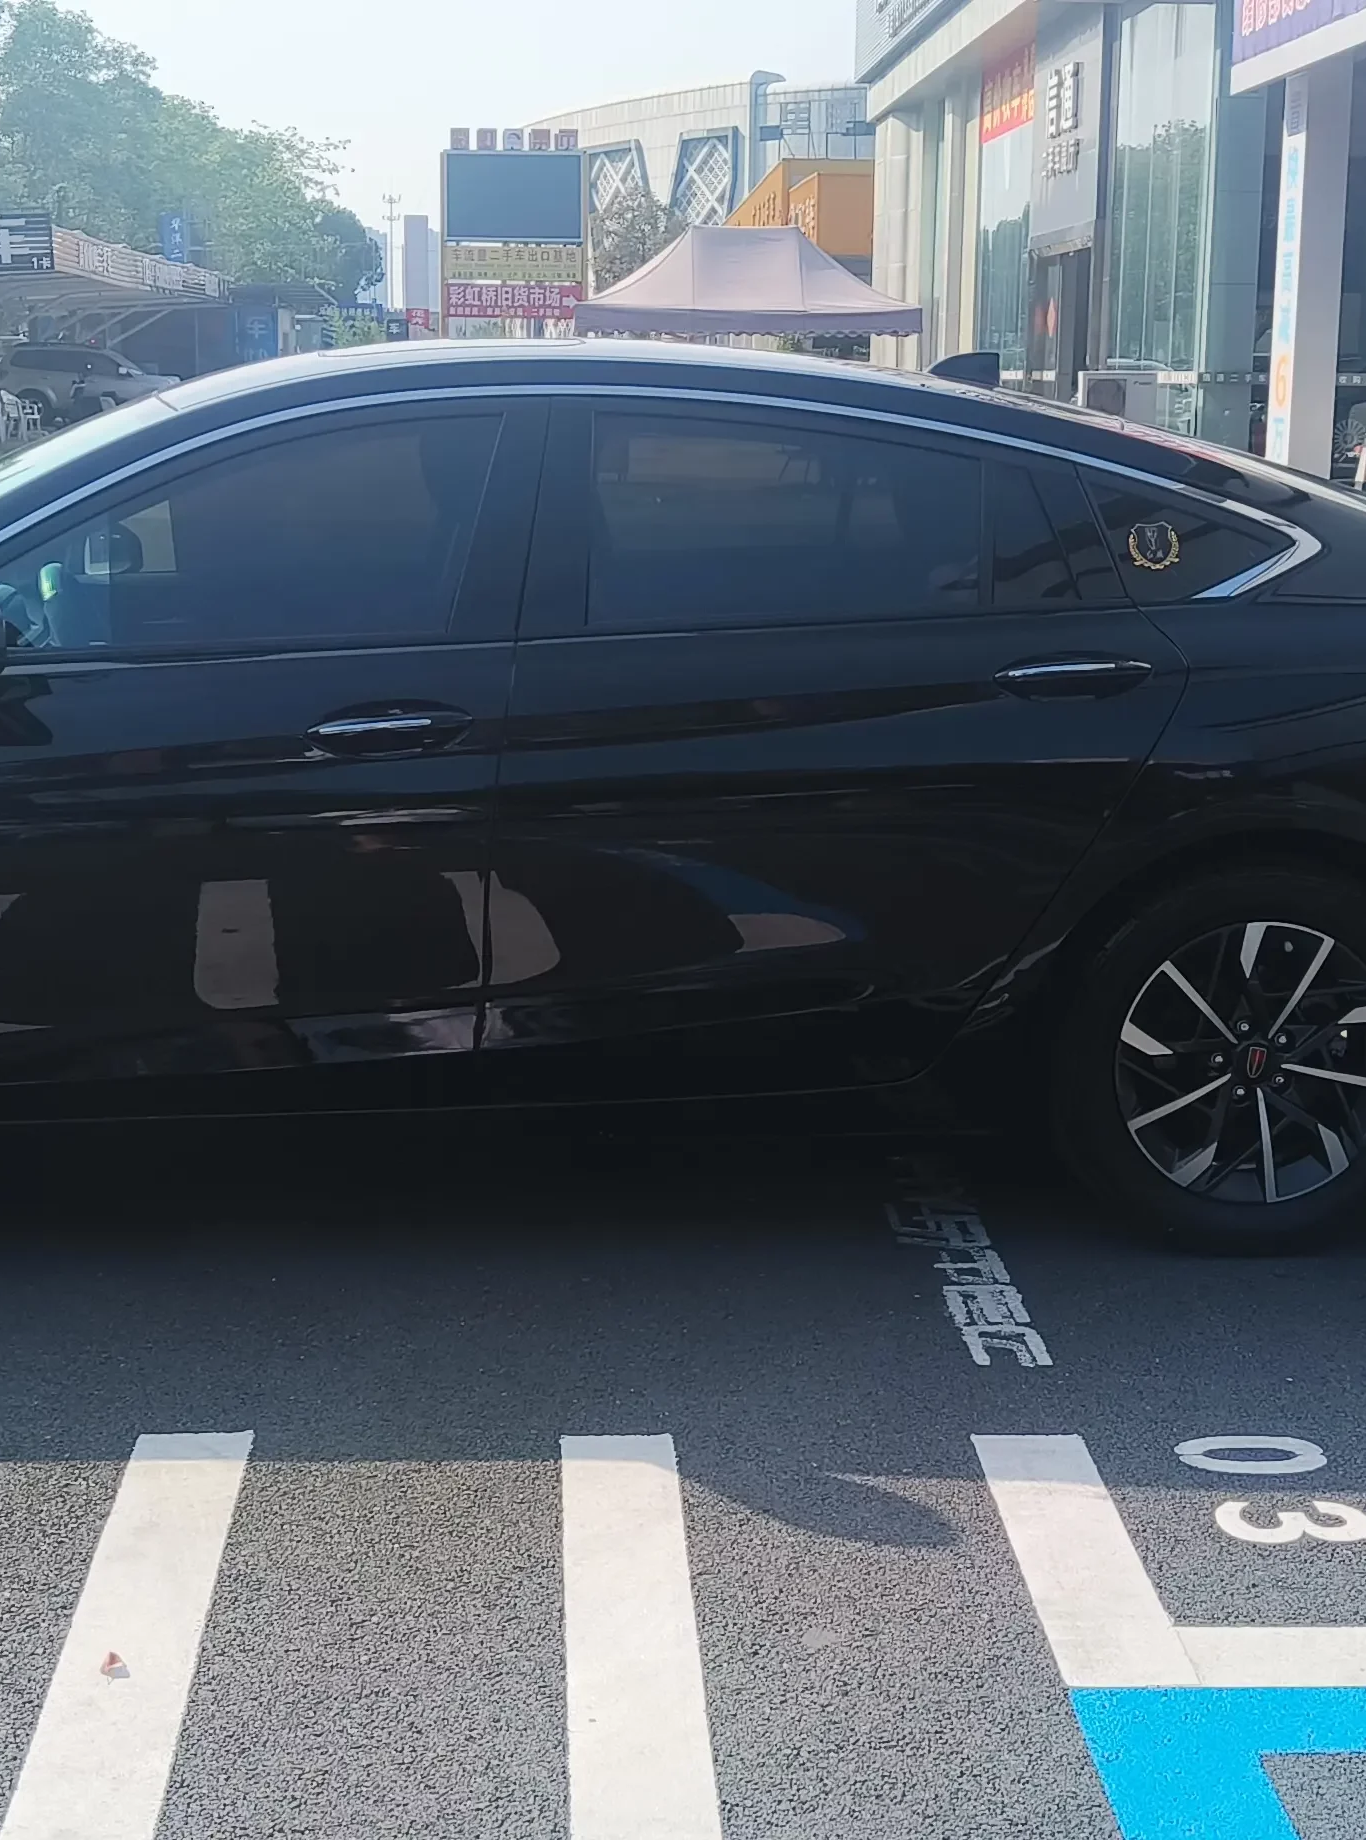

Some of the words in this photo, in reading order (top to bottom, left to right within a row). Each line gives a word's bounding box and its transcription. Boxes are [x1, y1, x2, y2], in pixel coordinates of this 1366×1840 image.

[1047, 62, 1079, 139] 信通
[31, 256, 51, 270] 1卡
[449, 286, 561, 307] 彩虹桥旧货市场
